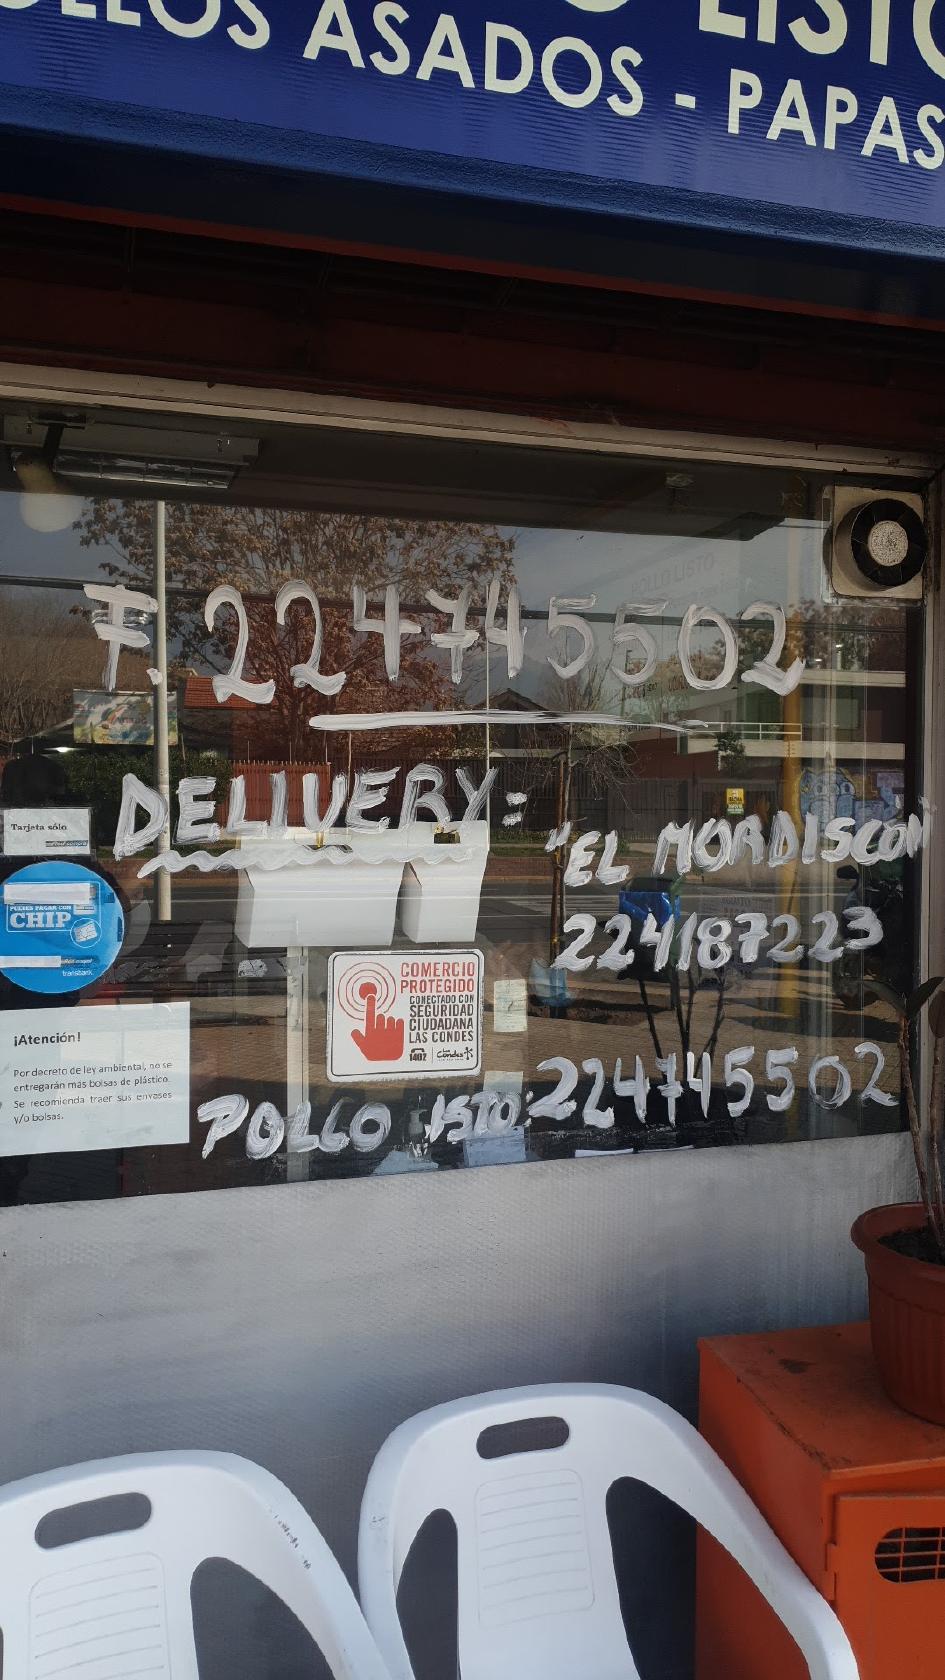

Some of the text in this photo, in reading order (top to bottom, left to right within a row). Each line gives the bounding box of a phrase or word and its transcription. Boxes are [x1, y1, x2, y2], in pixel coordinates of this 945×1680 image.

[303, 0, 644, 117] ASADOS
[727, 68, 945, 169] PAPAS
[11, 823, 67, 832] Tarjeta sólo
[9, 911, 72, 928] CHIP
[550, 906, 884, 973] 224187223
[400, 961, 475, 978] COMERCIO
[400, 978, 474, 993] PROTEGIDO
[409, 994, 474, 1004] CONECTADO CON
[409, 1004, 474, 1017] SEGURIDAD
[409, 1017, 474, 1031] CIUDADANA
[14, 1032, 81, 1047] ¡Atención!
[409, 1030, 474, 1043] LAS CONDES
[409, 1053, 427, 1061] 1402
[13, 1069, 30, 1078] Por
[31, 1067, 67, 1077] decreto
[69, 1066, 81, 1075] de
[83, 1065, 96, 1076] ley
[98, 1063, 147, 1073] ambiental,
[13, 1081, 65, 1092] entregarán
[89, 1078, 118, 1088] bolsas
[120, 1077, 131, 1086] de
[14, 1099, 25, 1108] Se
[30, 1096, 85, 1107] recomienda
[90, 1095, 113, 1103] traer
[136, 1092, 172, 1100] envases
[197, 1093, 391, 1160] POLLO
[527, 1042, 899, 1128] 224745502
[13, 1112, 64, 1124] y/o bolsas.
